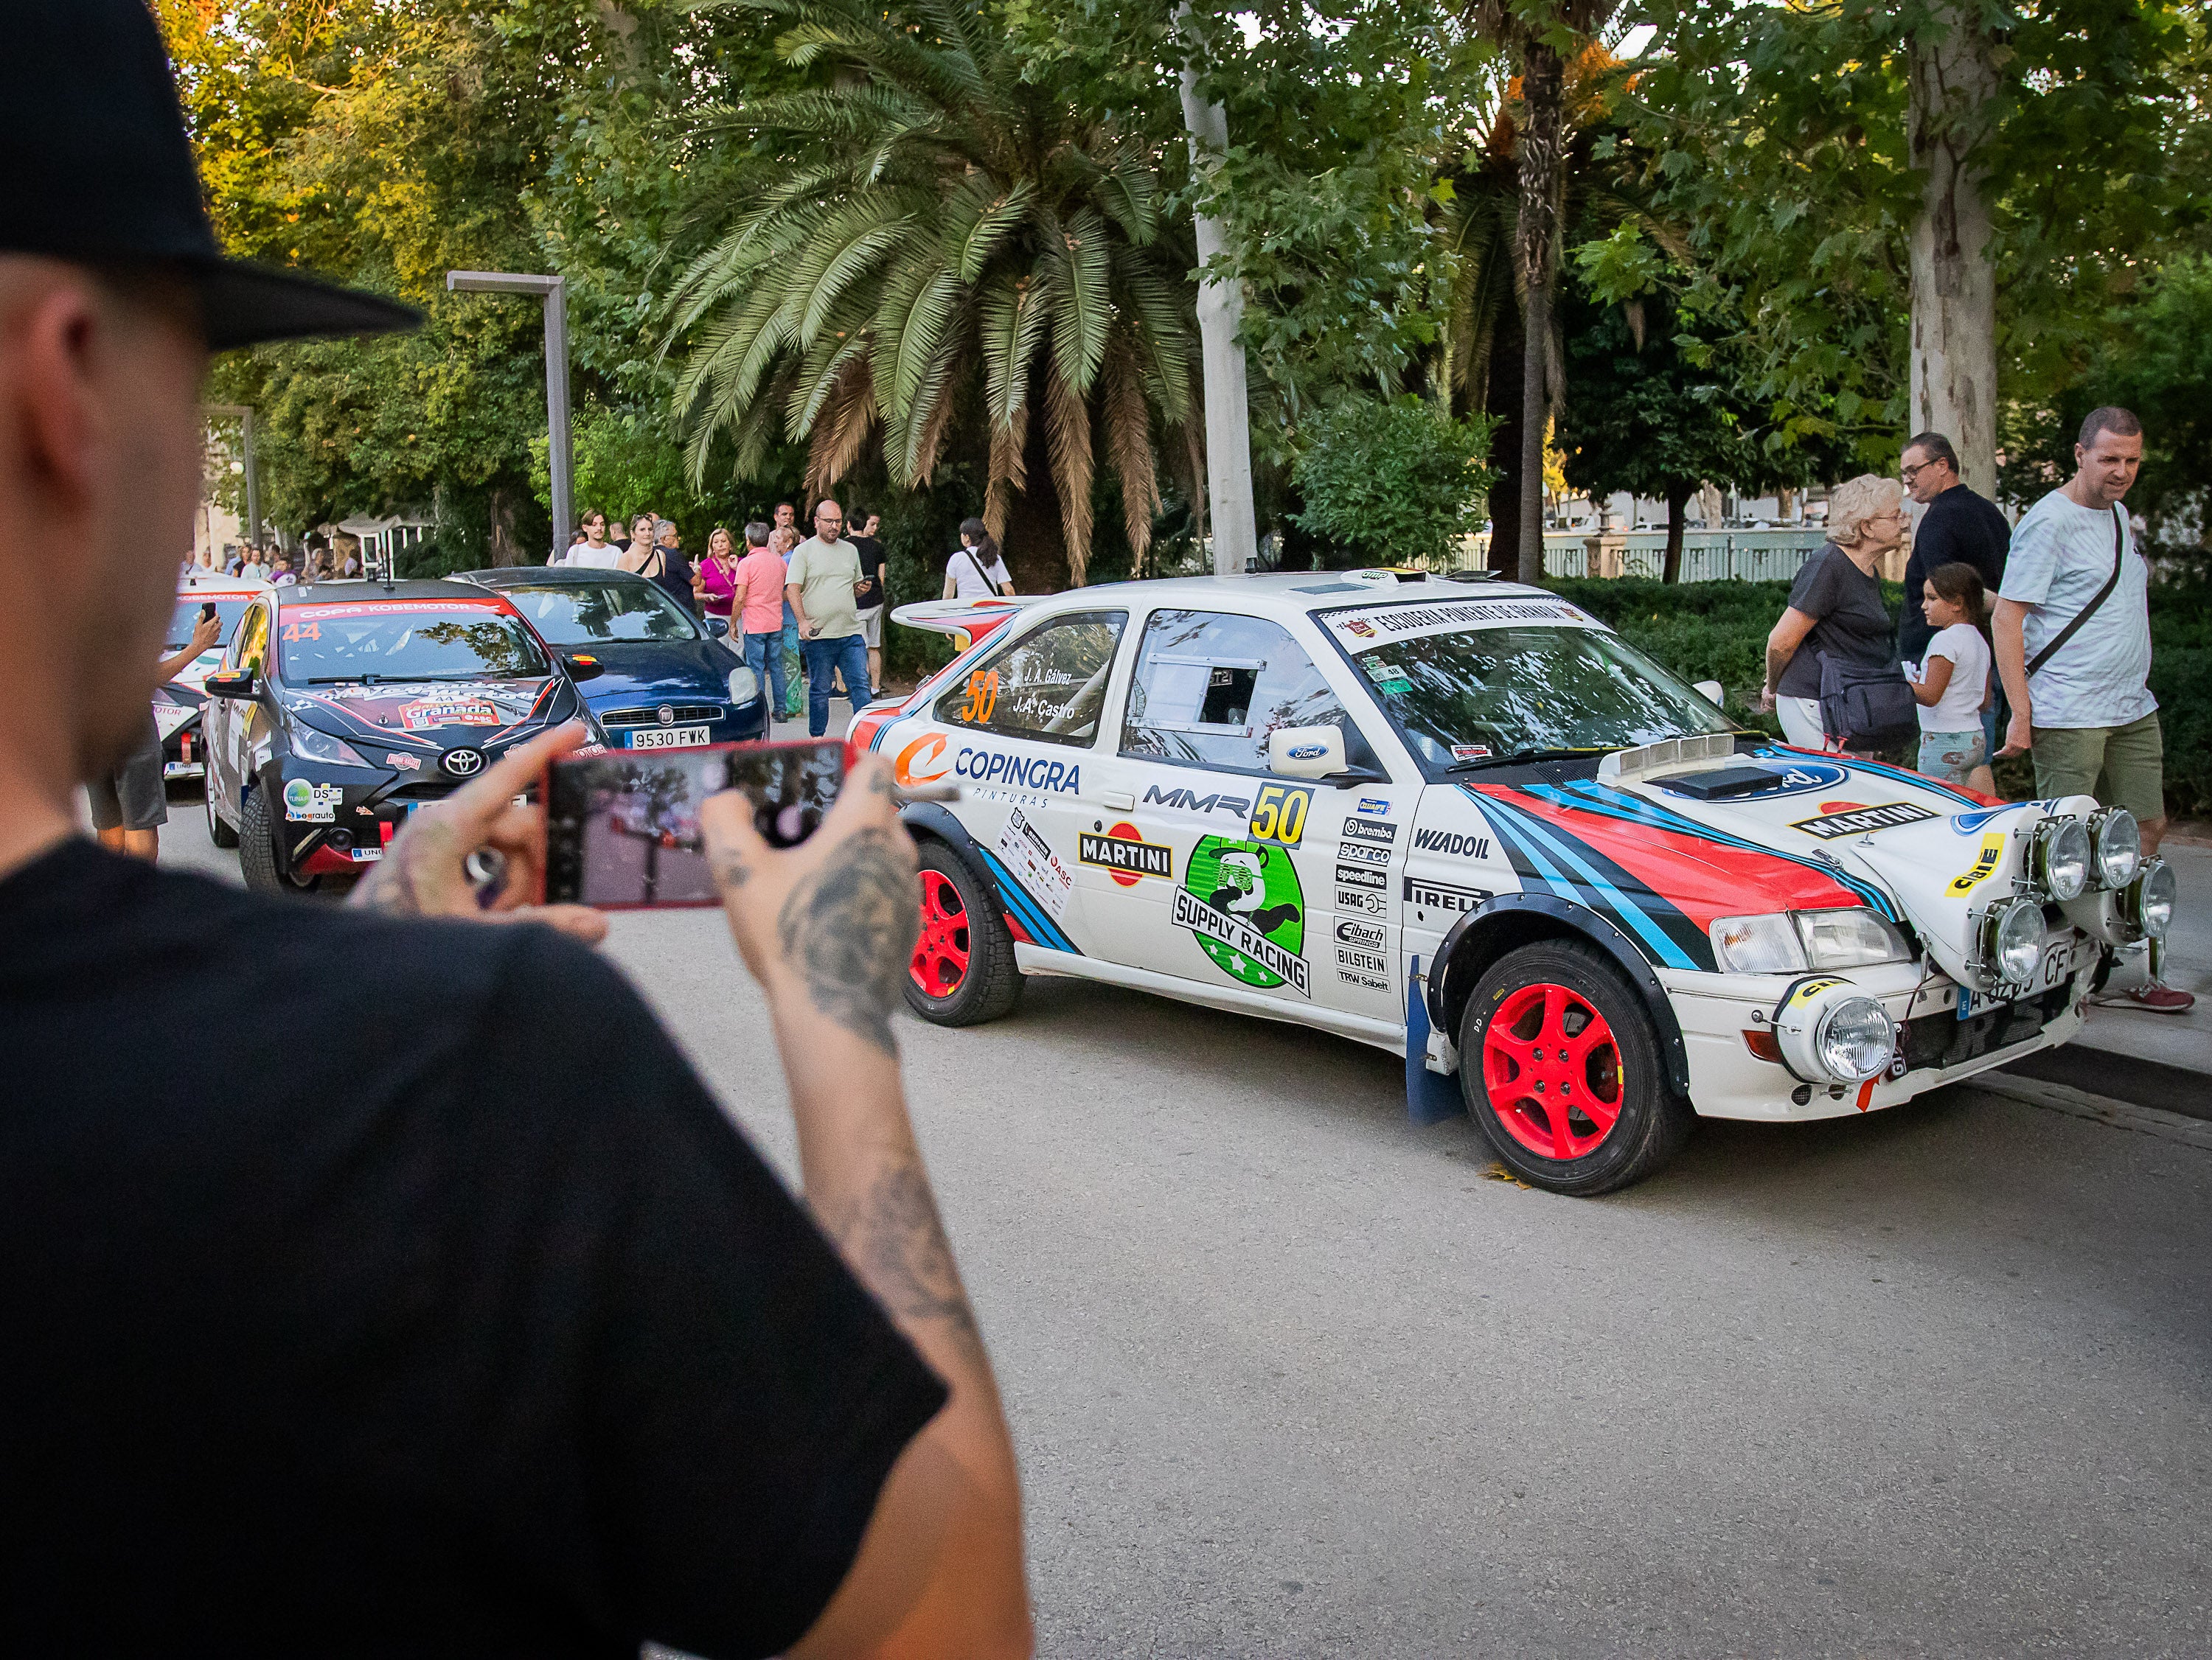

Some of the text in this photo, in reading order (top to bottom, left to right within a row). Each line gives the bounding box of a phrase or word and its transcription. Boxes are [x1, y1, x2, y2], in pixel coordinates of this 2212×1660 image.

[299, 603, 470, 618] COPA KOBEMOTOR
[1374, 608, 1450, 632] ESCUDERIA
[1445, 605, 1503, 623] PONIENTE
[1491, 605, 1519, 618] DE
[1507, 604, 1565, 619] GRANADA
[282, 622, 322, 642] 44
[1045, 668, 1072, 686] Gálvez
[961, 670, 999, 724] 50
[406, 705, 492, 719] Granada
[1038, 700, 1075, 719] Castro
[636, 729, 706, 747] 9530 FWK
[1295, 745, 1321, 760] Ford
[956, 747, 1080, 795] COPINGRA
[313, 789, 329, 798] DS
[973, 788, 1048, 808] PINTURAS
[1142, 784, 1310, 845] MMR 50
[1801, 804, 1933, 837] MARTINI
[1082, 838, 1168, 873] MARTINI
[1340, 843, 1390, 862] sparco
[1338, 869, 1385, 886] speedline
[1338, 890, 1363, 908] USAG
[1337, 921, 1383, 941] Eibach
[1176, 894, 1305, 990] SUPPLY RACING
[1349, 937, 1378, 948] SPRINGS
[1338, 949, 1385, 972] BILSTEIN
[1338, 971, 1389, 991] TRW Sabelt
